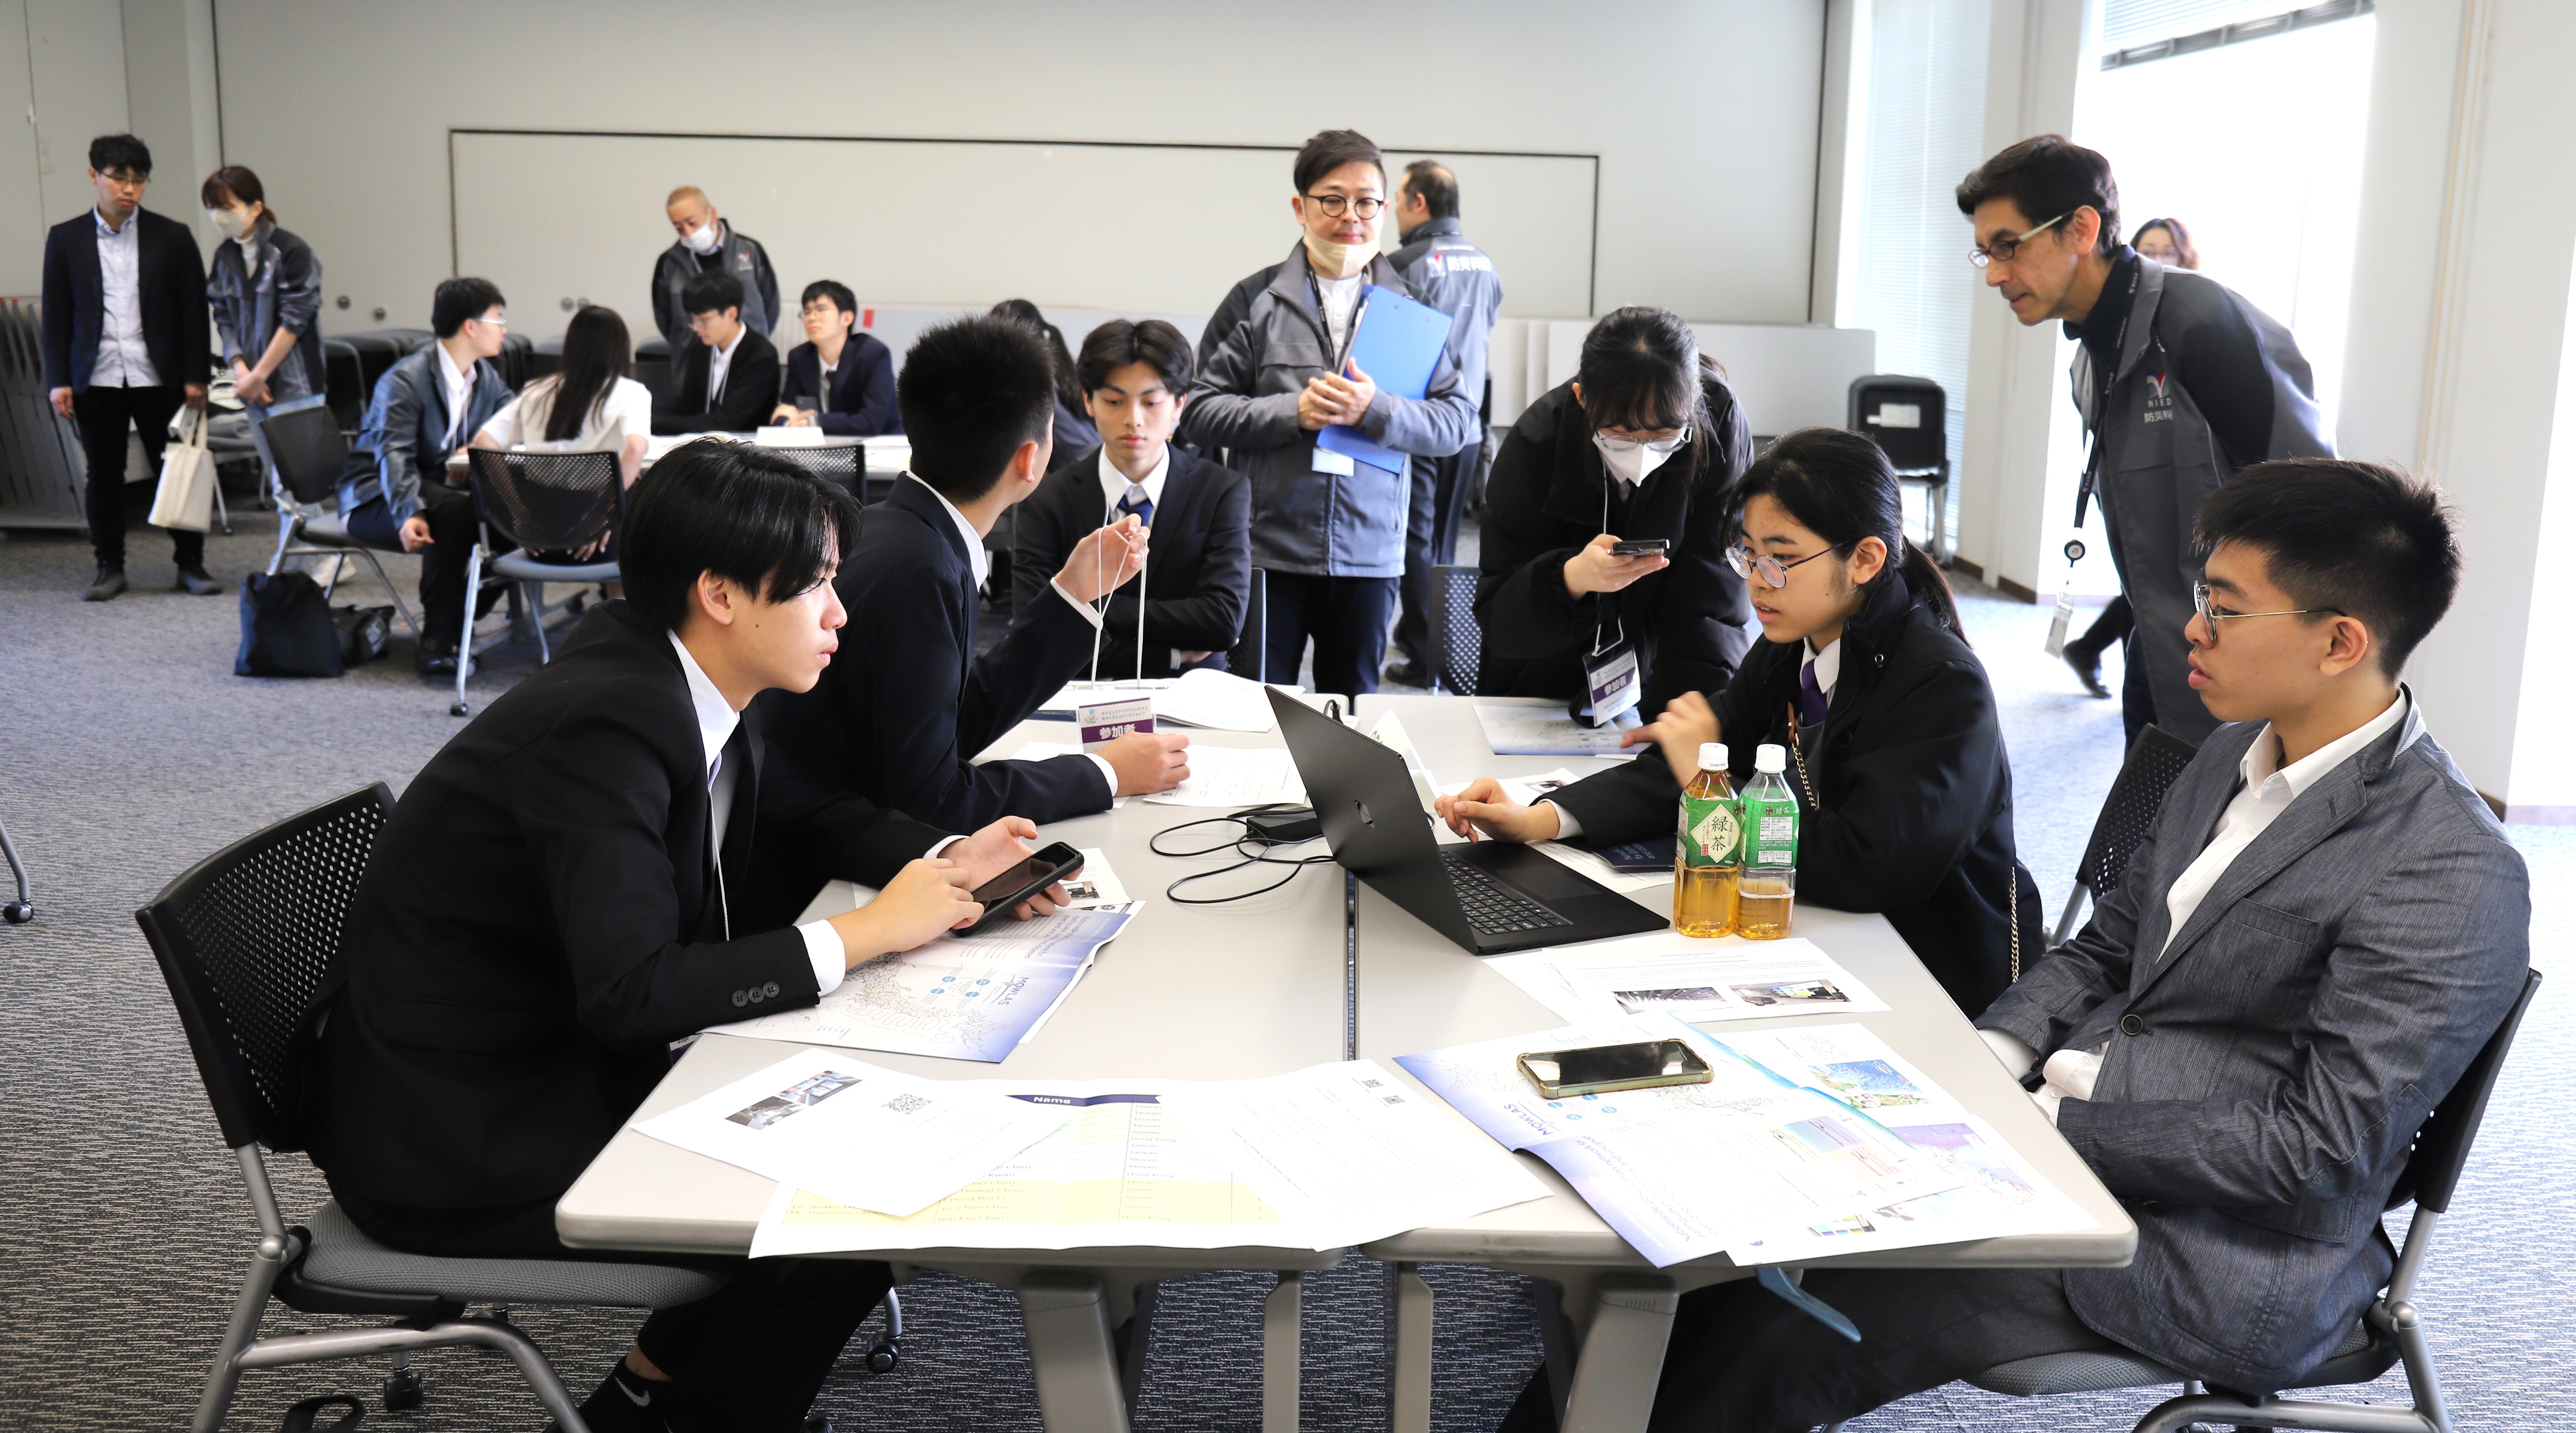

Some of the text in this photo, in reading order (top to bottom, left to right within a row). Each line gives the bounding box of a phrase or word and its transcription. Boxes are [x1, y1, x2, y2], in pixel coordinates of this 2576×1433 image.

[2148, 398, 2172, 407] NIED
[1604, 675, 1627, 696] 参加者
[1101, 706, 1148, 716] サイエンスアイデアコンテスト
[1775, 806, 1791, 815] 緑茶
[1711, 816, 1728, 851] 緑茶
[998, 977, 1030, 1005] MOWLAS
[1504, 1104, 1554, 1135] MOWLAS
[1584, 1145, 1614, 1167] network
[1651, 1206, 1694, 1242] Nationwide
